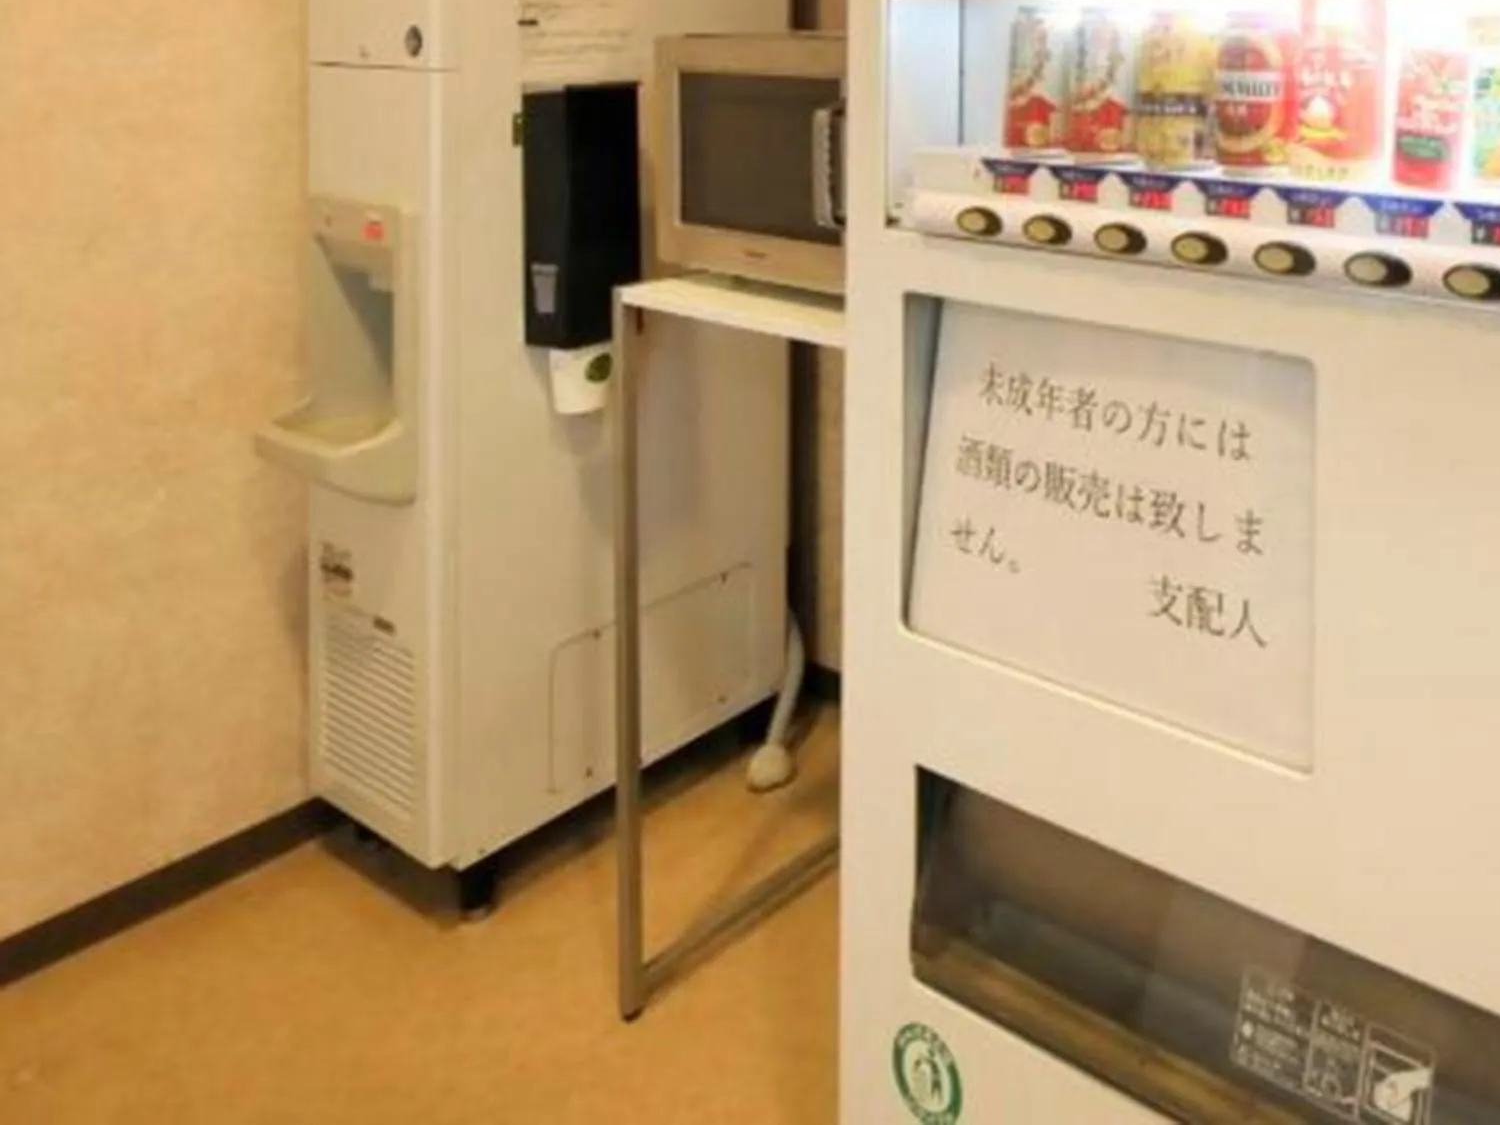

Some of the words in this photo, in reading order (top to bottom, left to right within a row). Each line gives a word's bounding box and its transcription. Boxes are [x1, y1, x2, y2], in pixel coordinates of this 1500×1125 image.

[979, 362, 1253, 463] 未成年者の方には
[954, 434, 1264, 556] 酒類の販売は致しま
[949, 516, 1022, 574] せん。
[1147, 574, 1268, 649] 支配人
